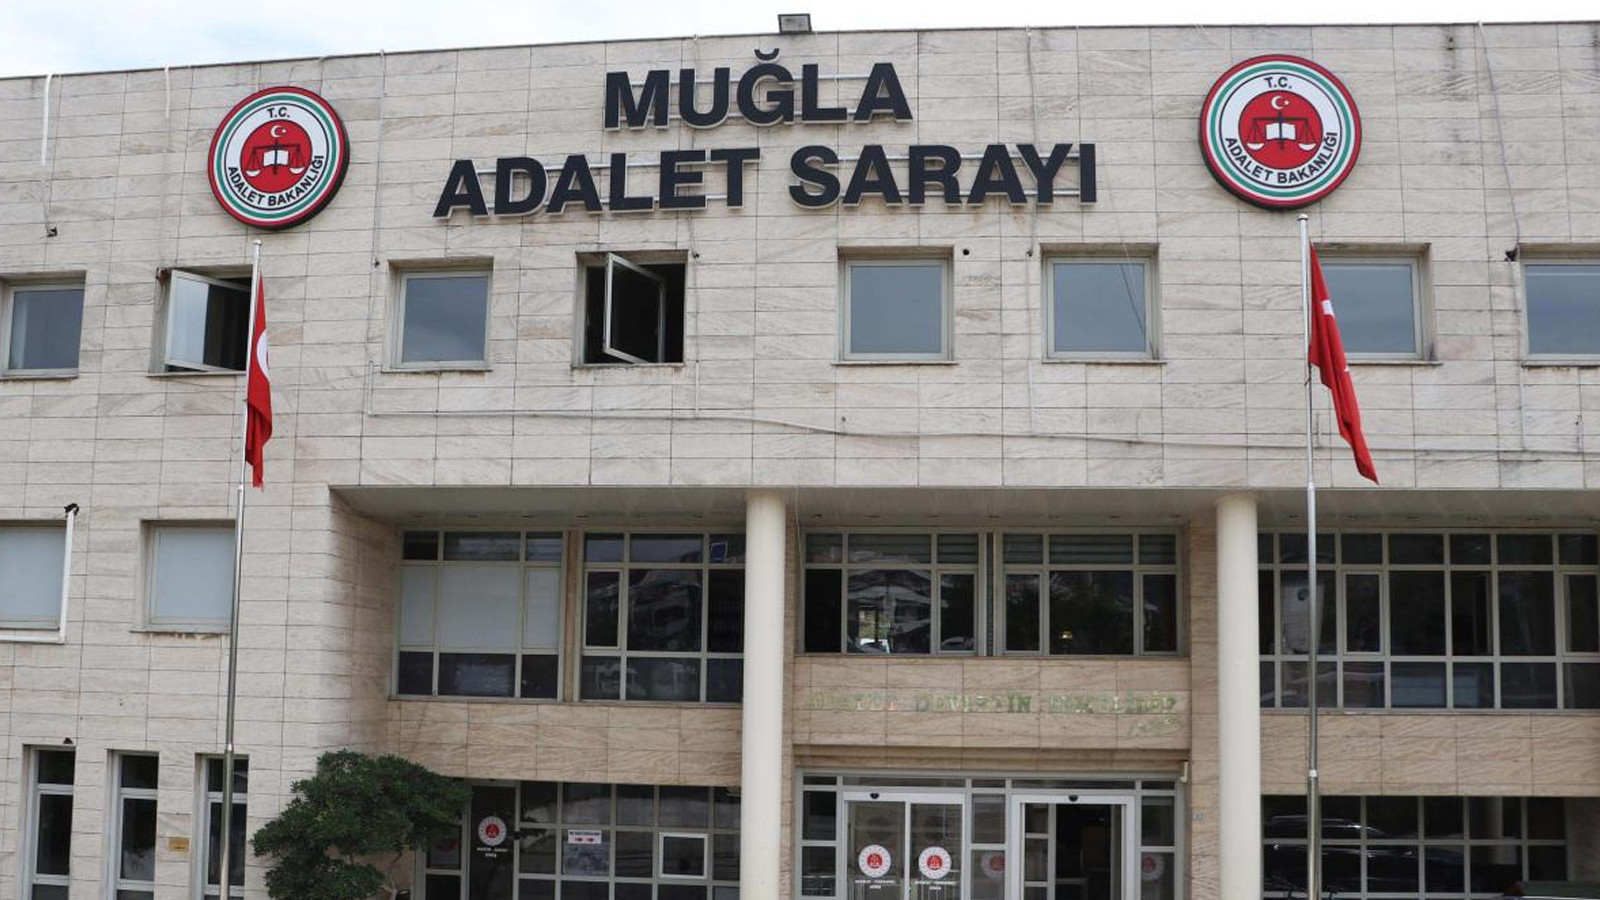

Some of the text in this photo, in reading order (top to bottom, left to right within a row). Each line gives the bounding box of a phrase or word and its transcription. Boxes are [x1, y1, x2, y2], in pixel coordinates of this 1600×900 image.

[604, 48, 912, 130] MUĞLA
[1264, 76, 1292, 89] T.C.
[267, 106, 290, 119] T.C.
[228, 155, 324, 207] ADALET BAKANLIĞI
[432, 143, 1096, 218] ADALET SARAYI
[1225, 131, 1338, 184] ADALET BAKANLIĞI
